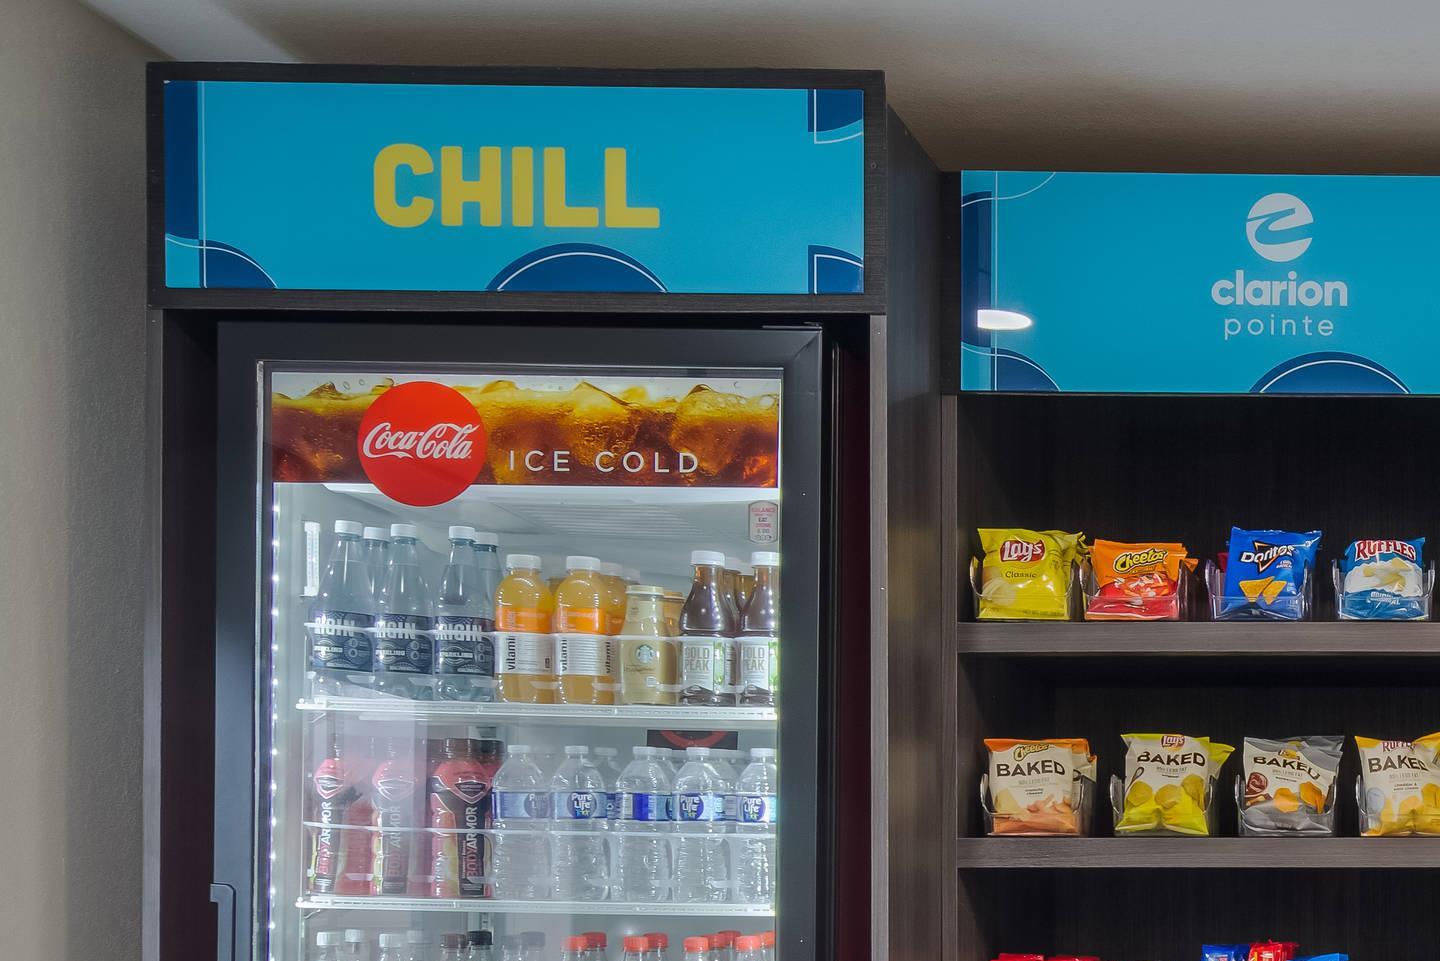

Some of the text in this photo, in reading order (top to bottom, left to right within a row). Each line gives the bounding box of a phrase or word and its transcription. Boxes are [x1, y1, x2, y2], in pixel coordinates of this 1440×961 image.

[373, 142, 660, 229] CHILL
[1211, 269, 1348, 307] clarion
[1224, 315, 1335, 341] pointe
[362, 421, 479, 461] Coca-Cola
[508, 449, 699, 474] ICE COLD
[1112, 547, 1169, 573] Cheetos
[1240, 545, 1295, 563] Doritos
[1355, 539, 1416, 562] RUFFLES
[684, 659, 710, 671] PEAK
[996, 760, 1065, 777] BAKED
[1137, 751, 1206, 767] BAKED
